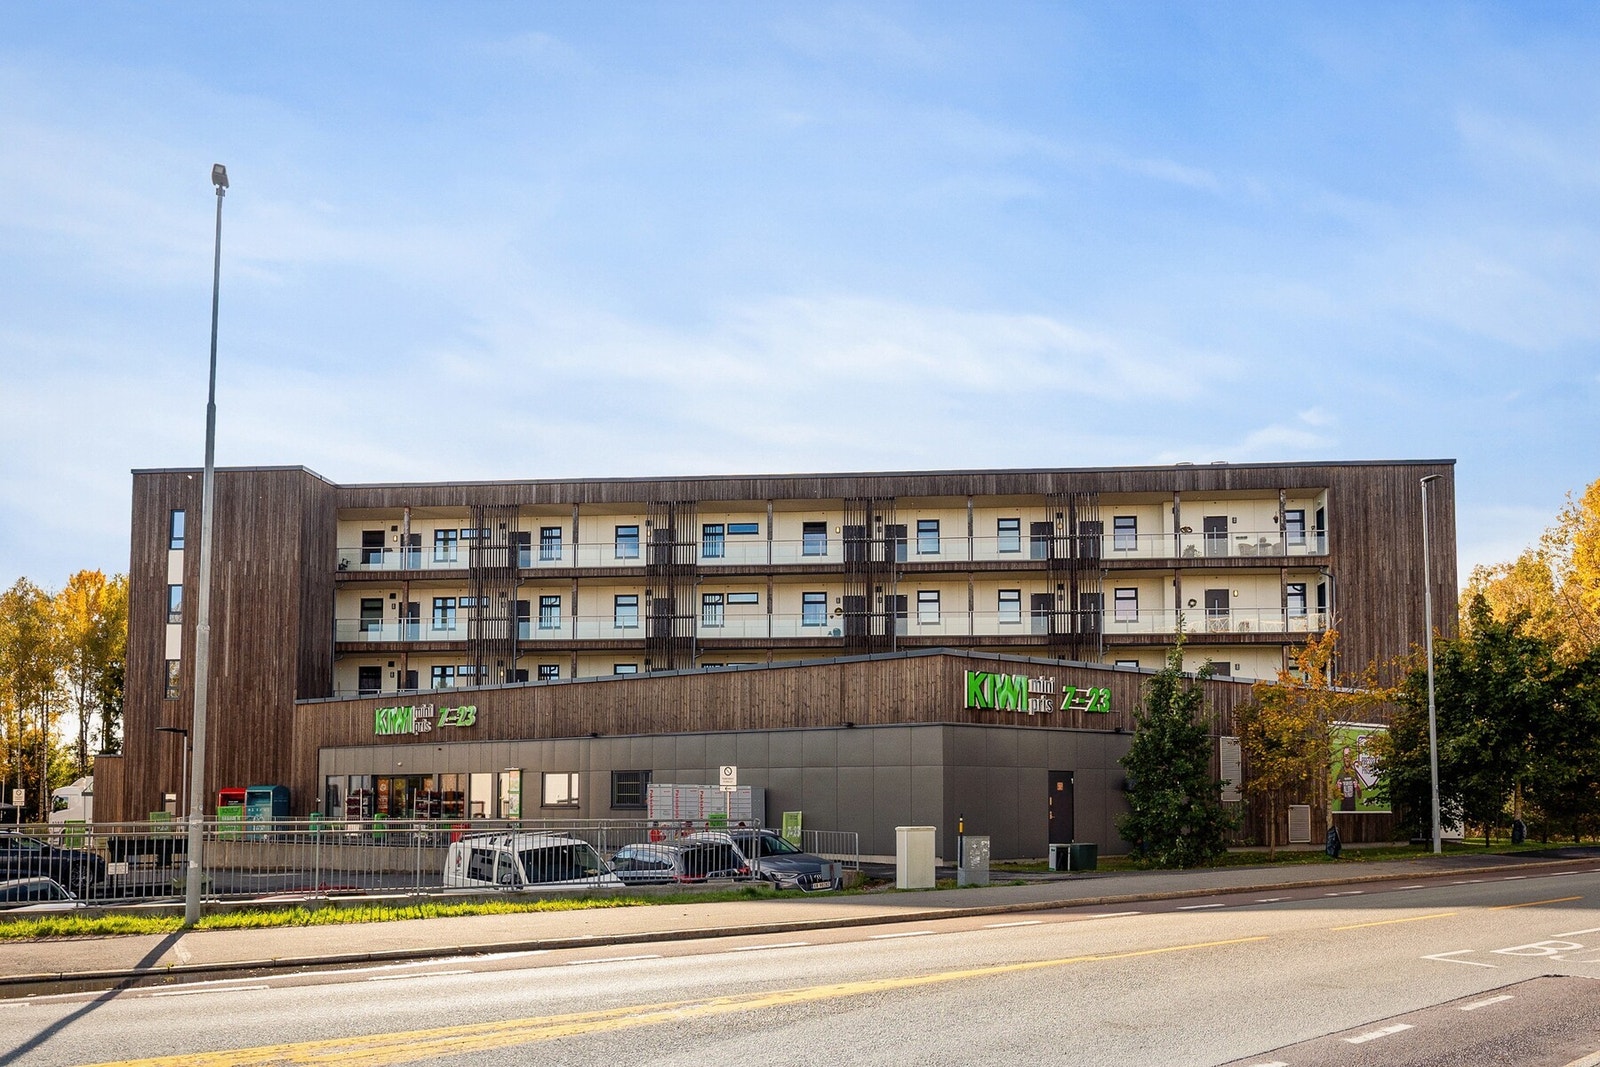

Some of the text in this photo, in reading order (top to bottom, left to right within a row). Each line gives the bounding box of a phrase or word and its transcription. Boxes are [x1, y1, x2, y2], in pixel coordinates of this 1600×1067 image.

[964, 670, 1029, 712] KIWI
[1028, 676, 1055, 694] mini
[1028, 695, 1054, 715] pris
[1060, 685, 1112, 713] 7-23
[375, 706, 414, 735] KIWI
[414, 704, 434, 718] mini
[437, 706, 477, 728] 7-23
[414, 719, 432, 735] pris
